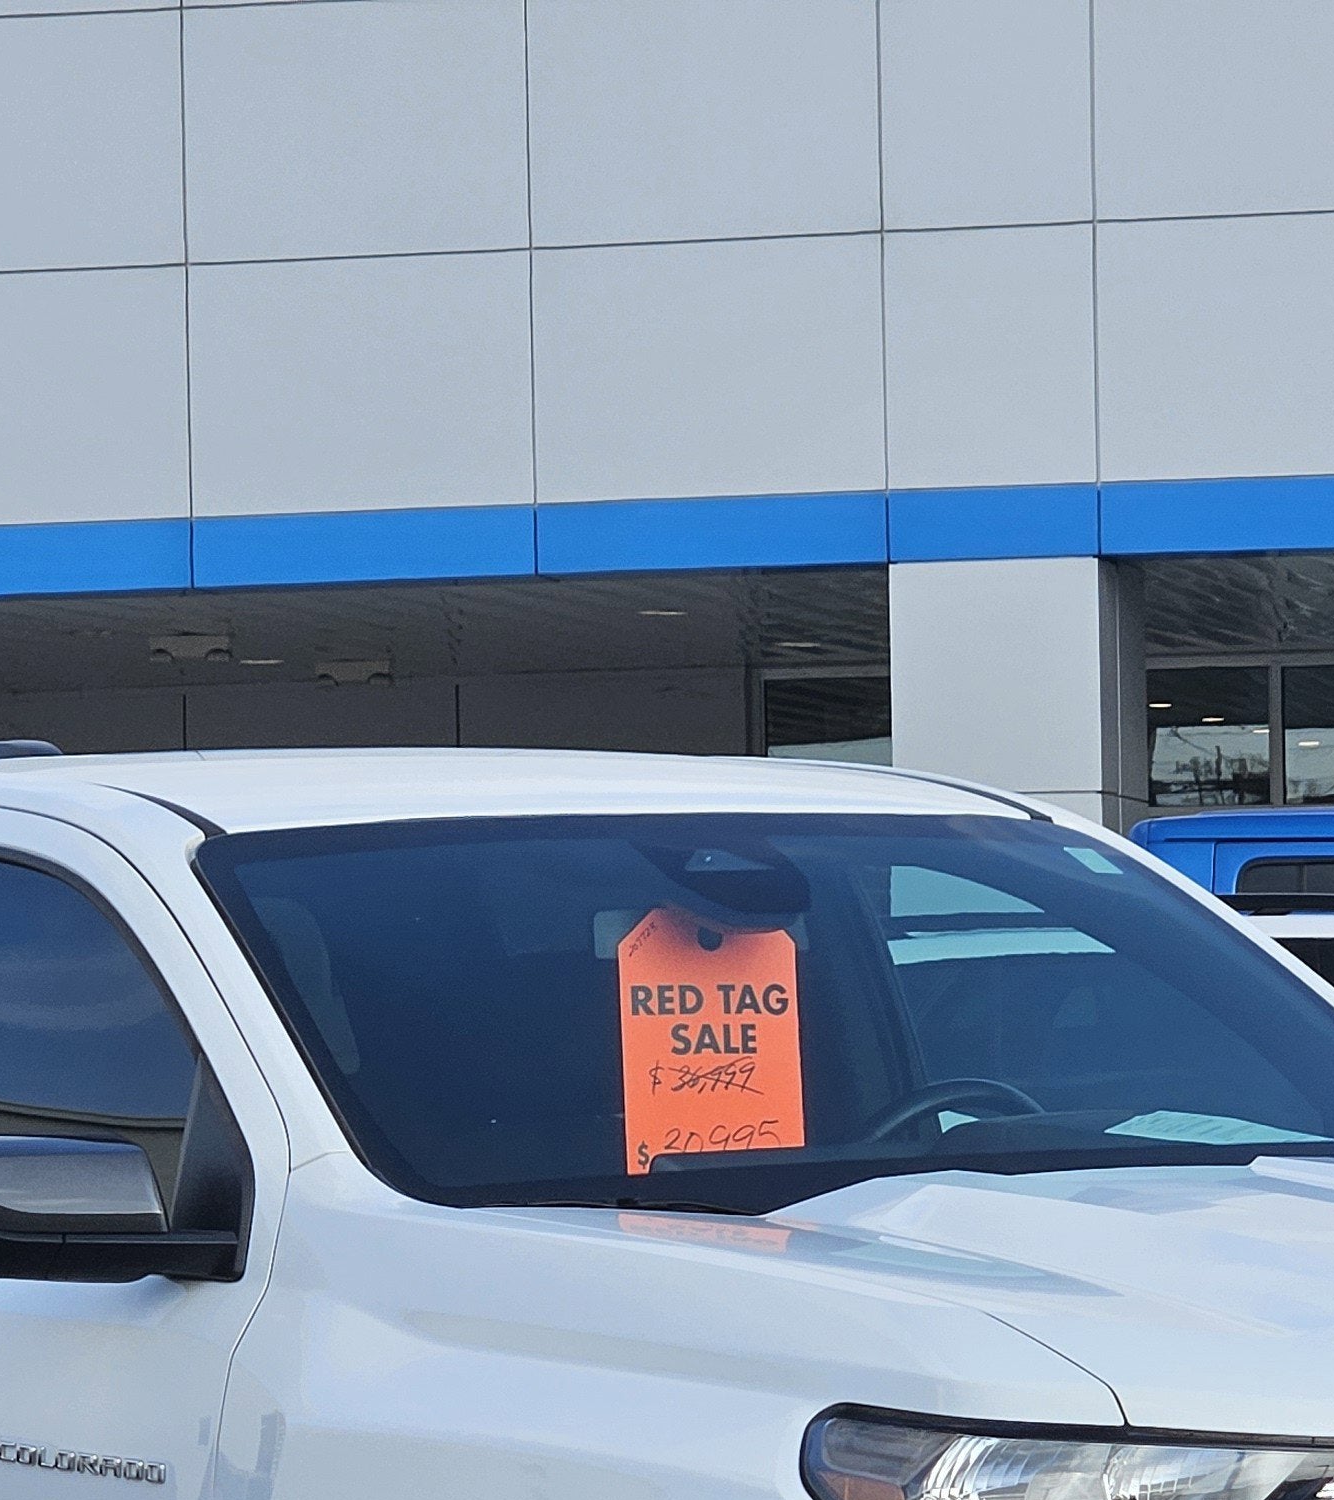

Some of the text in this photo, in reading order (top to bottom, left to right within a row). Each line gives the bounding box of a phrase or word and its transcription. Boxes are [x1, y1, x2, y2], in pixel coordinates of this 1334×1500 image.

[630, 983, 789, 1016] RED TAG
[670, 1023, 758, 1056] SALE
